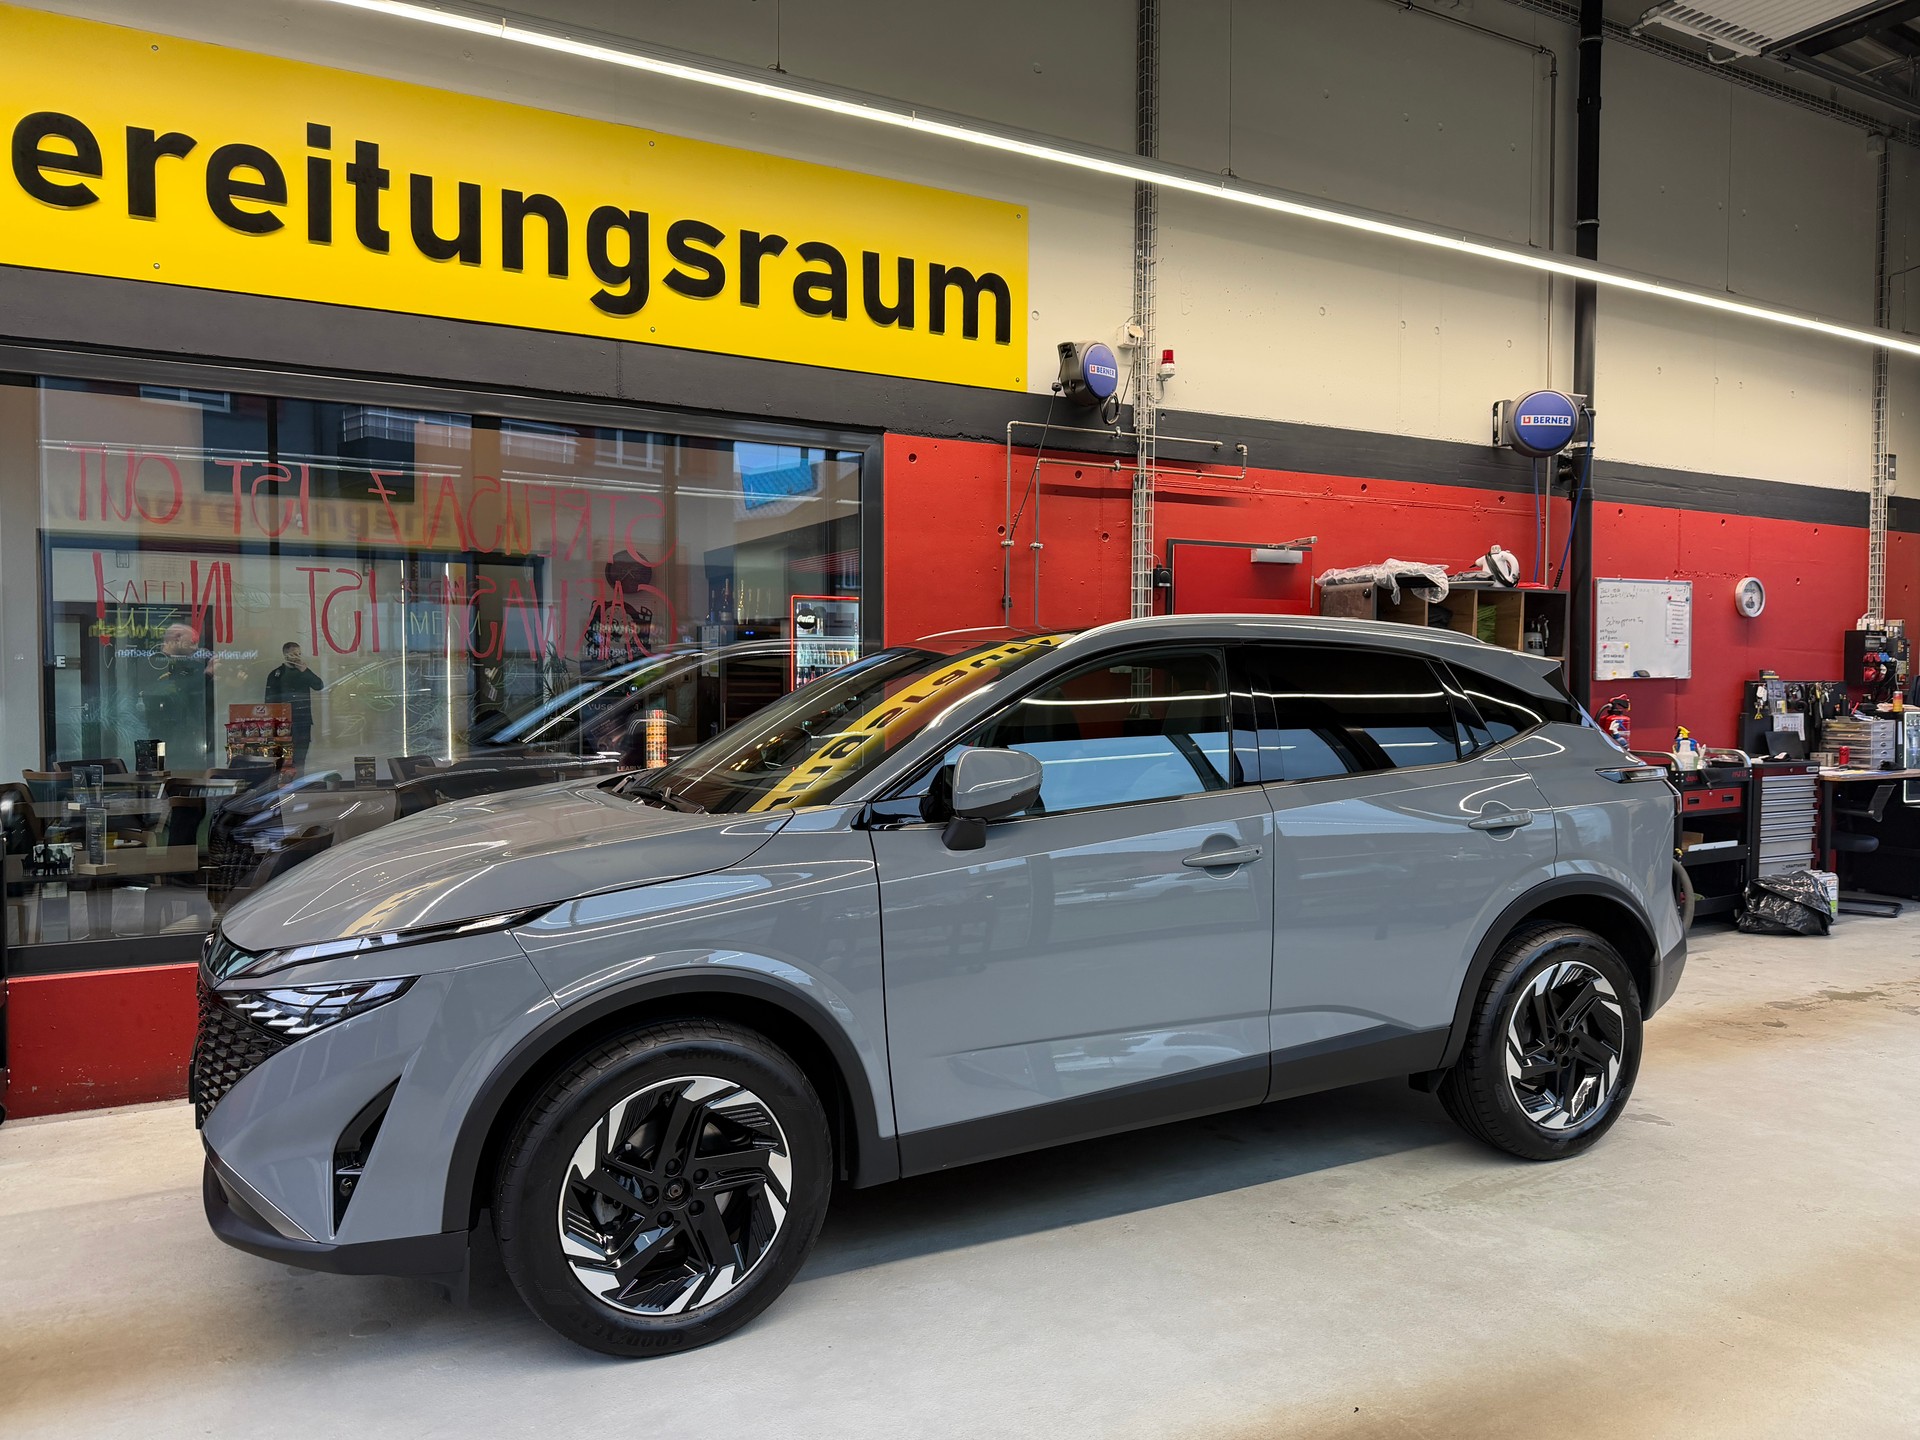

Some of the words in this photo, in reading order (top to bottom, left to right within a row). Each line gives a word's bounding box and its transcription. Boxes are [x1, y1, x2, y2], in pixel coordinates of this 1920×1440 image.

[11, 111, 1011, 345] ereitungsraum
[1096, 366, 1115, 377] BERNER
[1533, 416, 1569, 424] BERNER
